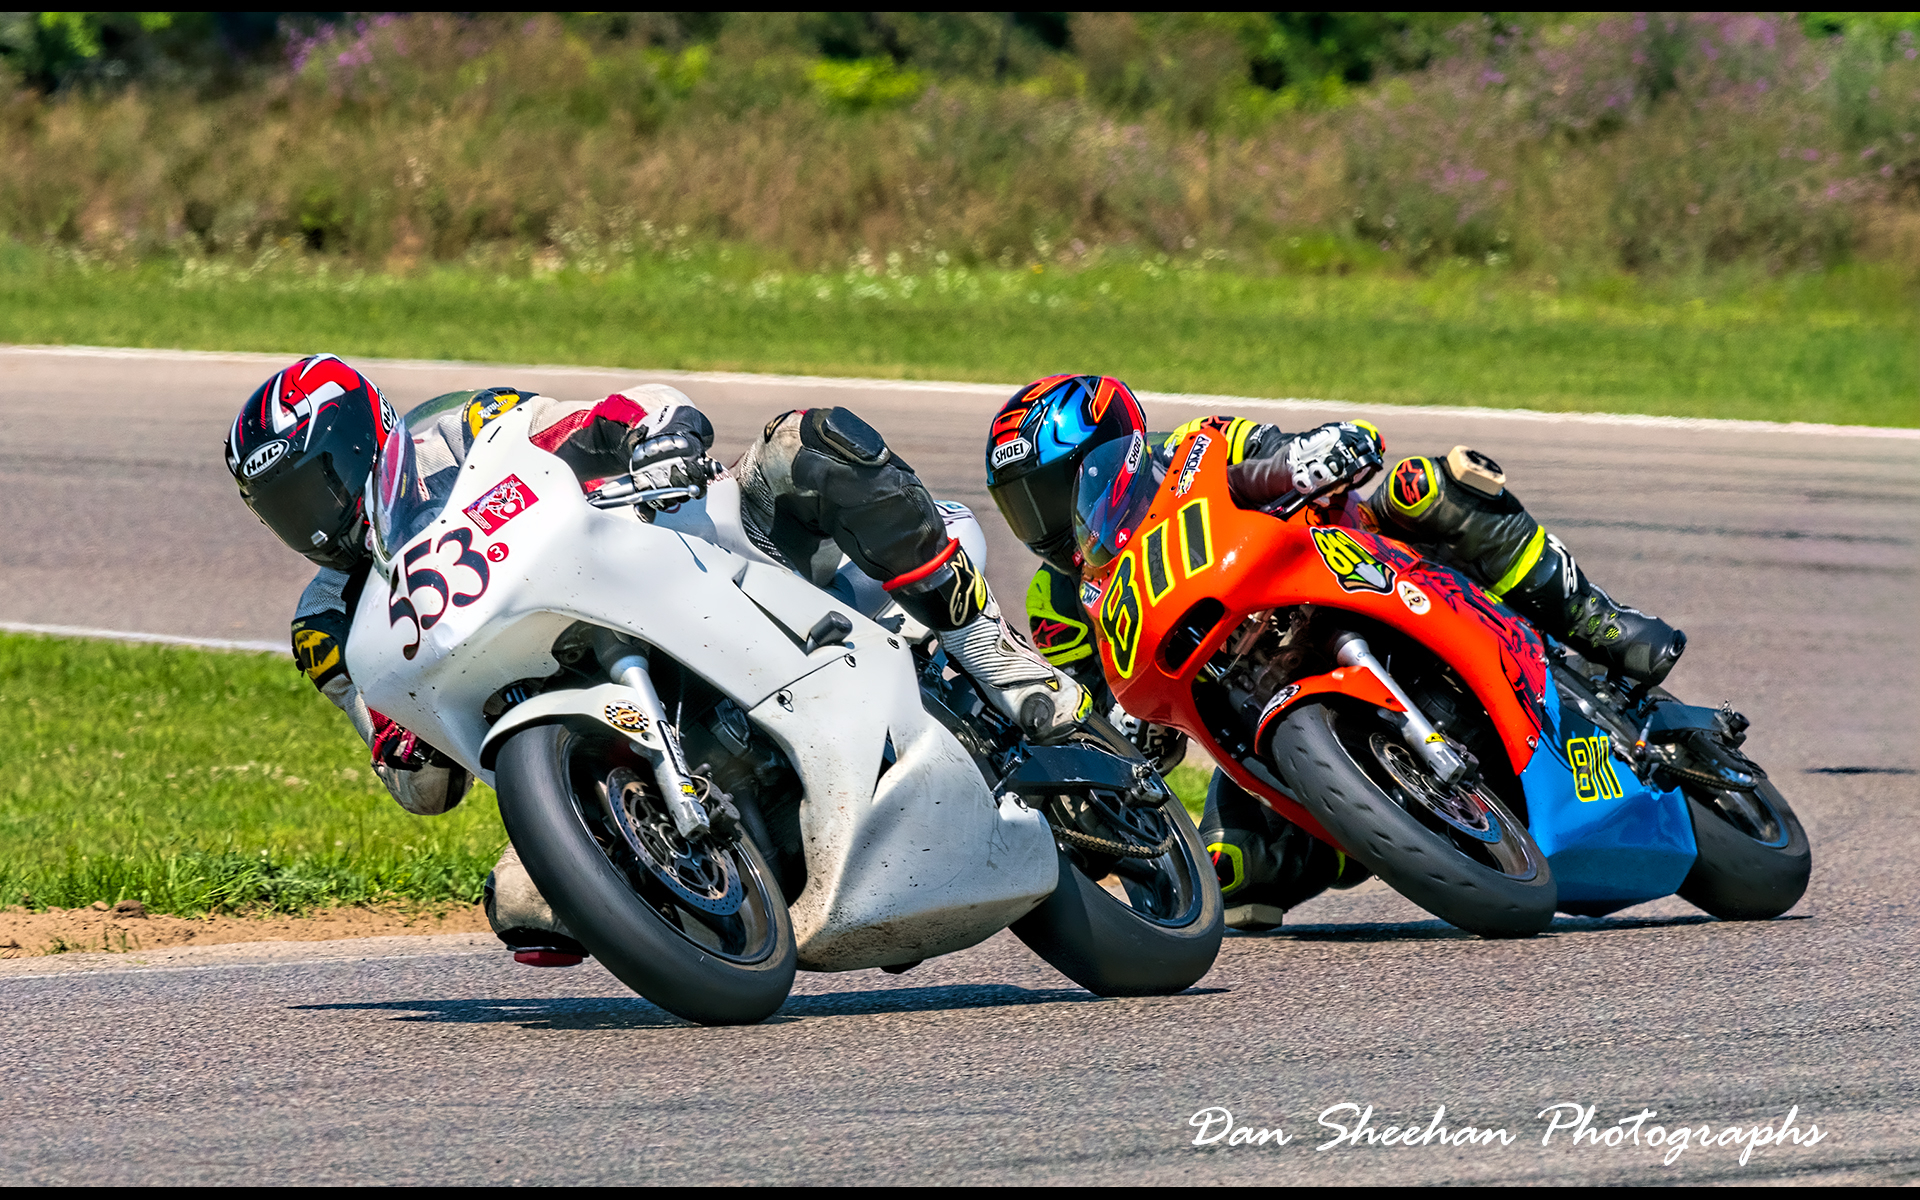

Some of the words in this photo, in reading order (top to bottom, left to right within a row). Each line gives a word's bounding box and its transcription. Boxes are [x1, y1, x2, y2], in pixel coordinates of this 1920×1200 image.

[246, 444, 280, 476] HJC
[995, 443, 1024, 464] SHOEI
[1128, 435, 1142, 468] SHOEI
[489, 545, 505, 561] 3
[1118, 532, 1128, 544] 4
[1314, 531, 1377, 575] 811
[389, 527, 490, 661] 553
[1100, 497, 1215, 679] 811
[1566, 736, 1624, 803] 811
